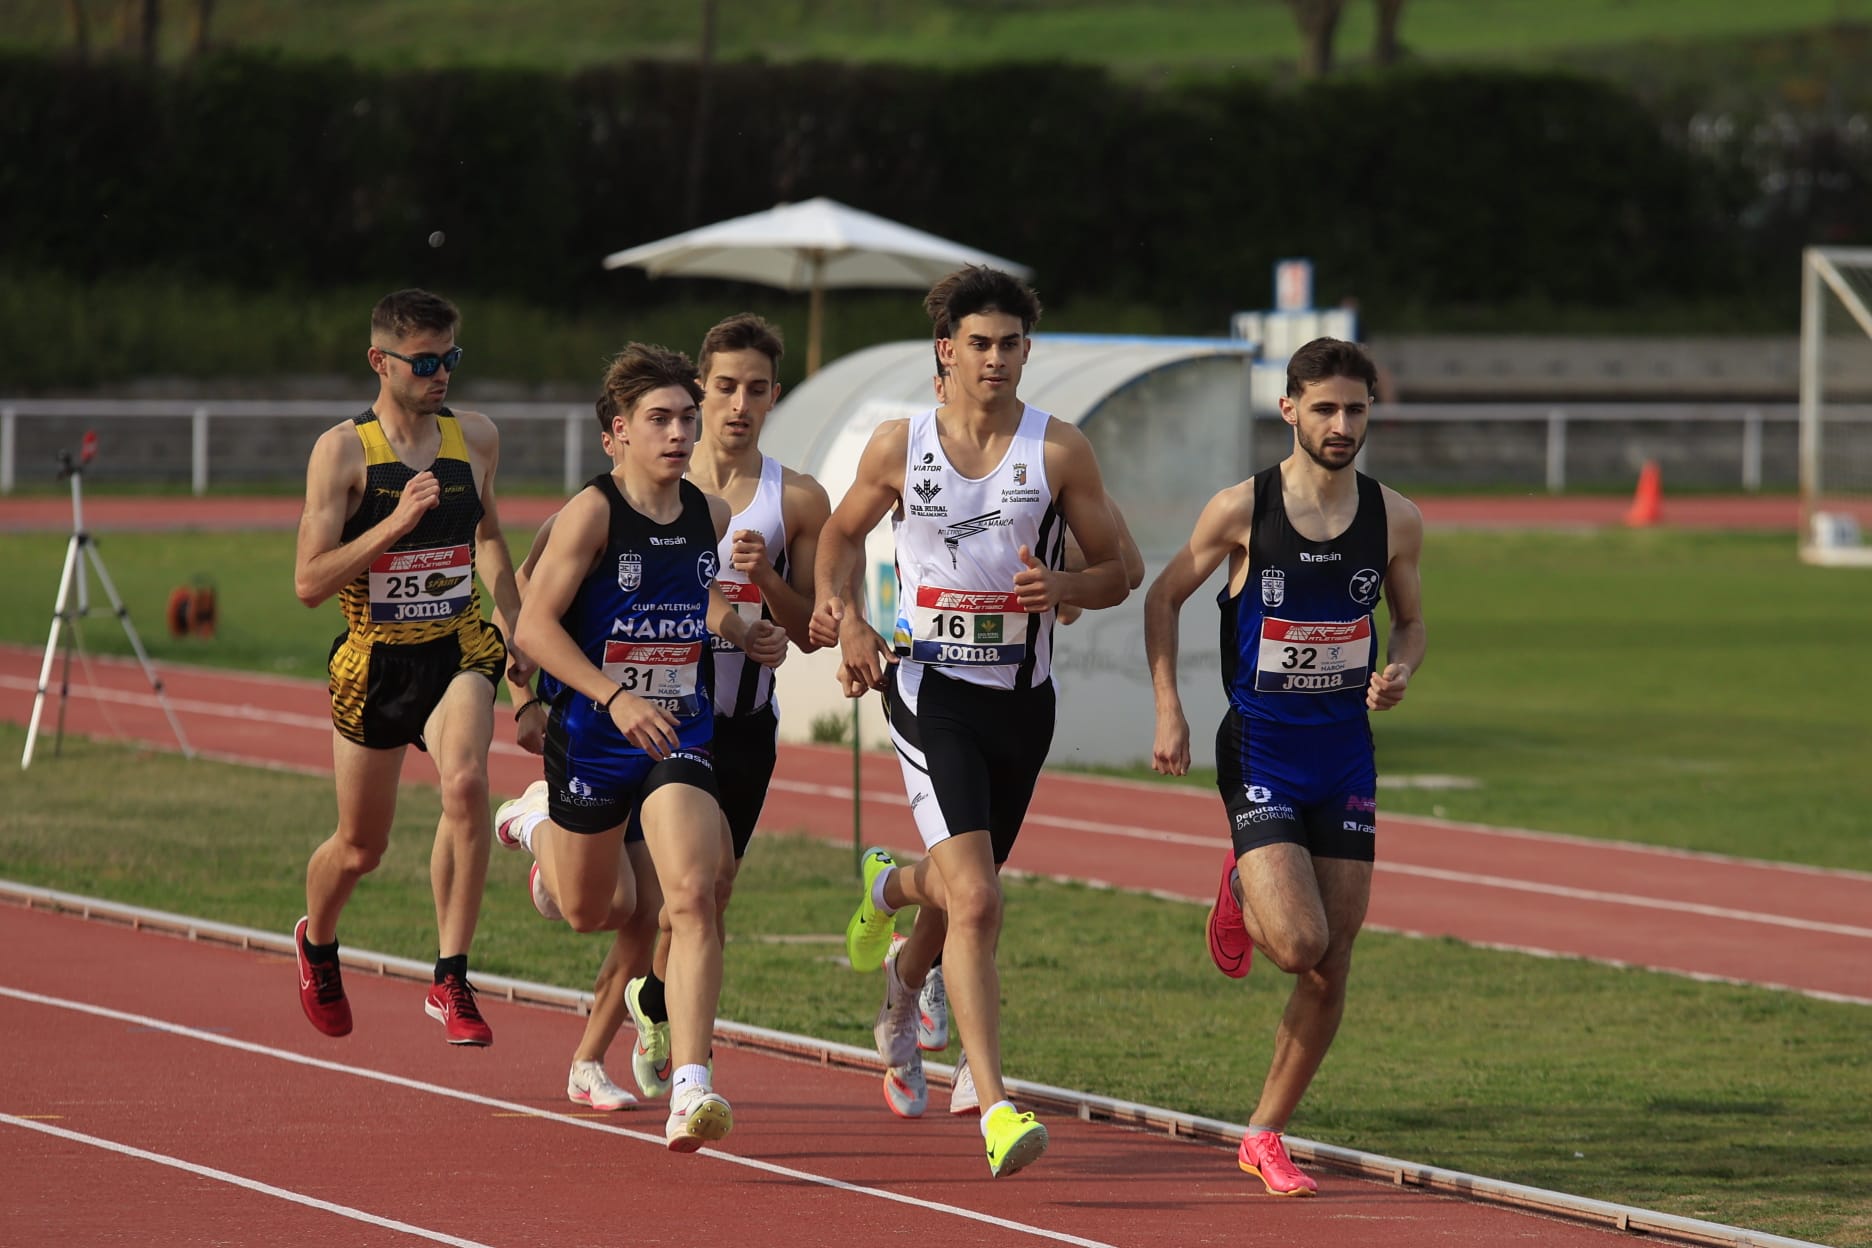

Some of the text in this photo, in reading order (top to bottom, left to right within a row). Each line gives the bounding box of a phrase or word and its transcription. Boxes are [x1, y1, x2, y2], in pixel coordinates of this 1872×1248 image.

[913, 464, 942, 472] VIATOR
[1001, 488, 1040, 496] Ayuntamiento
[1009, 495, 1040, 503] Salamanca
[413, 549, 454, 563] RFEA
[386, 575, 420, 599] 25
[428, 578, 461, 589] SPRINT
[961, 594, 1009, 606] RFEA
[631, 602, 701, 611] CLUB ATLETISMO
[932, 613, 966, 639] 16
[1311, 625, 1357, 637] RFEA
[651, 647, 692, 658] RFEA
[1281, 646, 1318, 670] 32
[621, 667, 654, 692] 31
[1236, 803, 1293, 823] Deputación
[1237, 821, 1250, 831] DA
